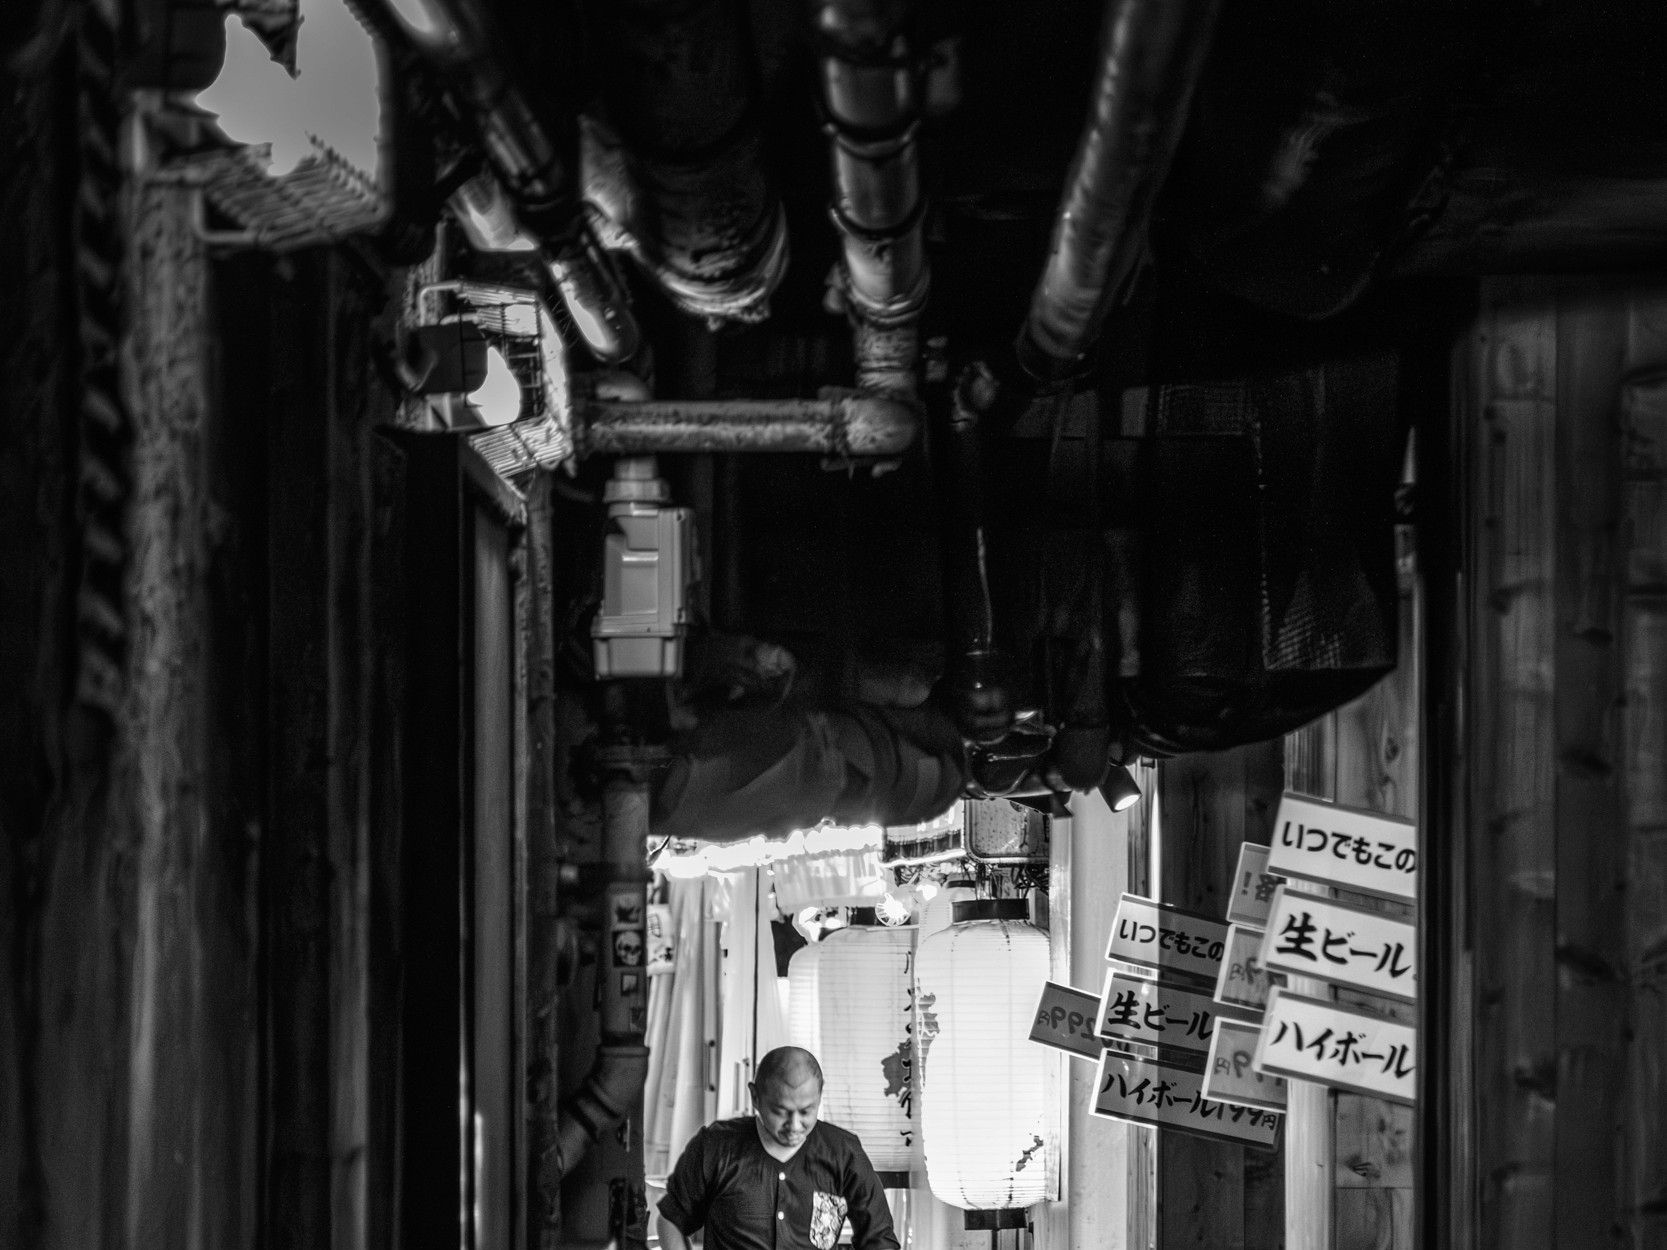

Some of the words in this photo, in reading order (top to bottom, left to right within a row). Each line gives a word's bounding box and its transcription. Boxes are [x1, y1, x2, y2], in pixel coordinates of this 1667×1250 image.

[1282, 821, 1416, 874] いつでもこの
[1120, 919, 1224, 962] いつでもこの
[1276, 913, 1412, 978] 生ビール
[1108, 990, 1212, 1040] 生ビール
[1270, 1021, 1416, 1079] ハイボール
